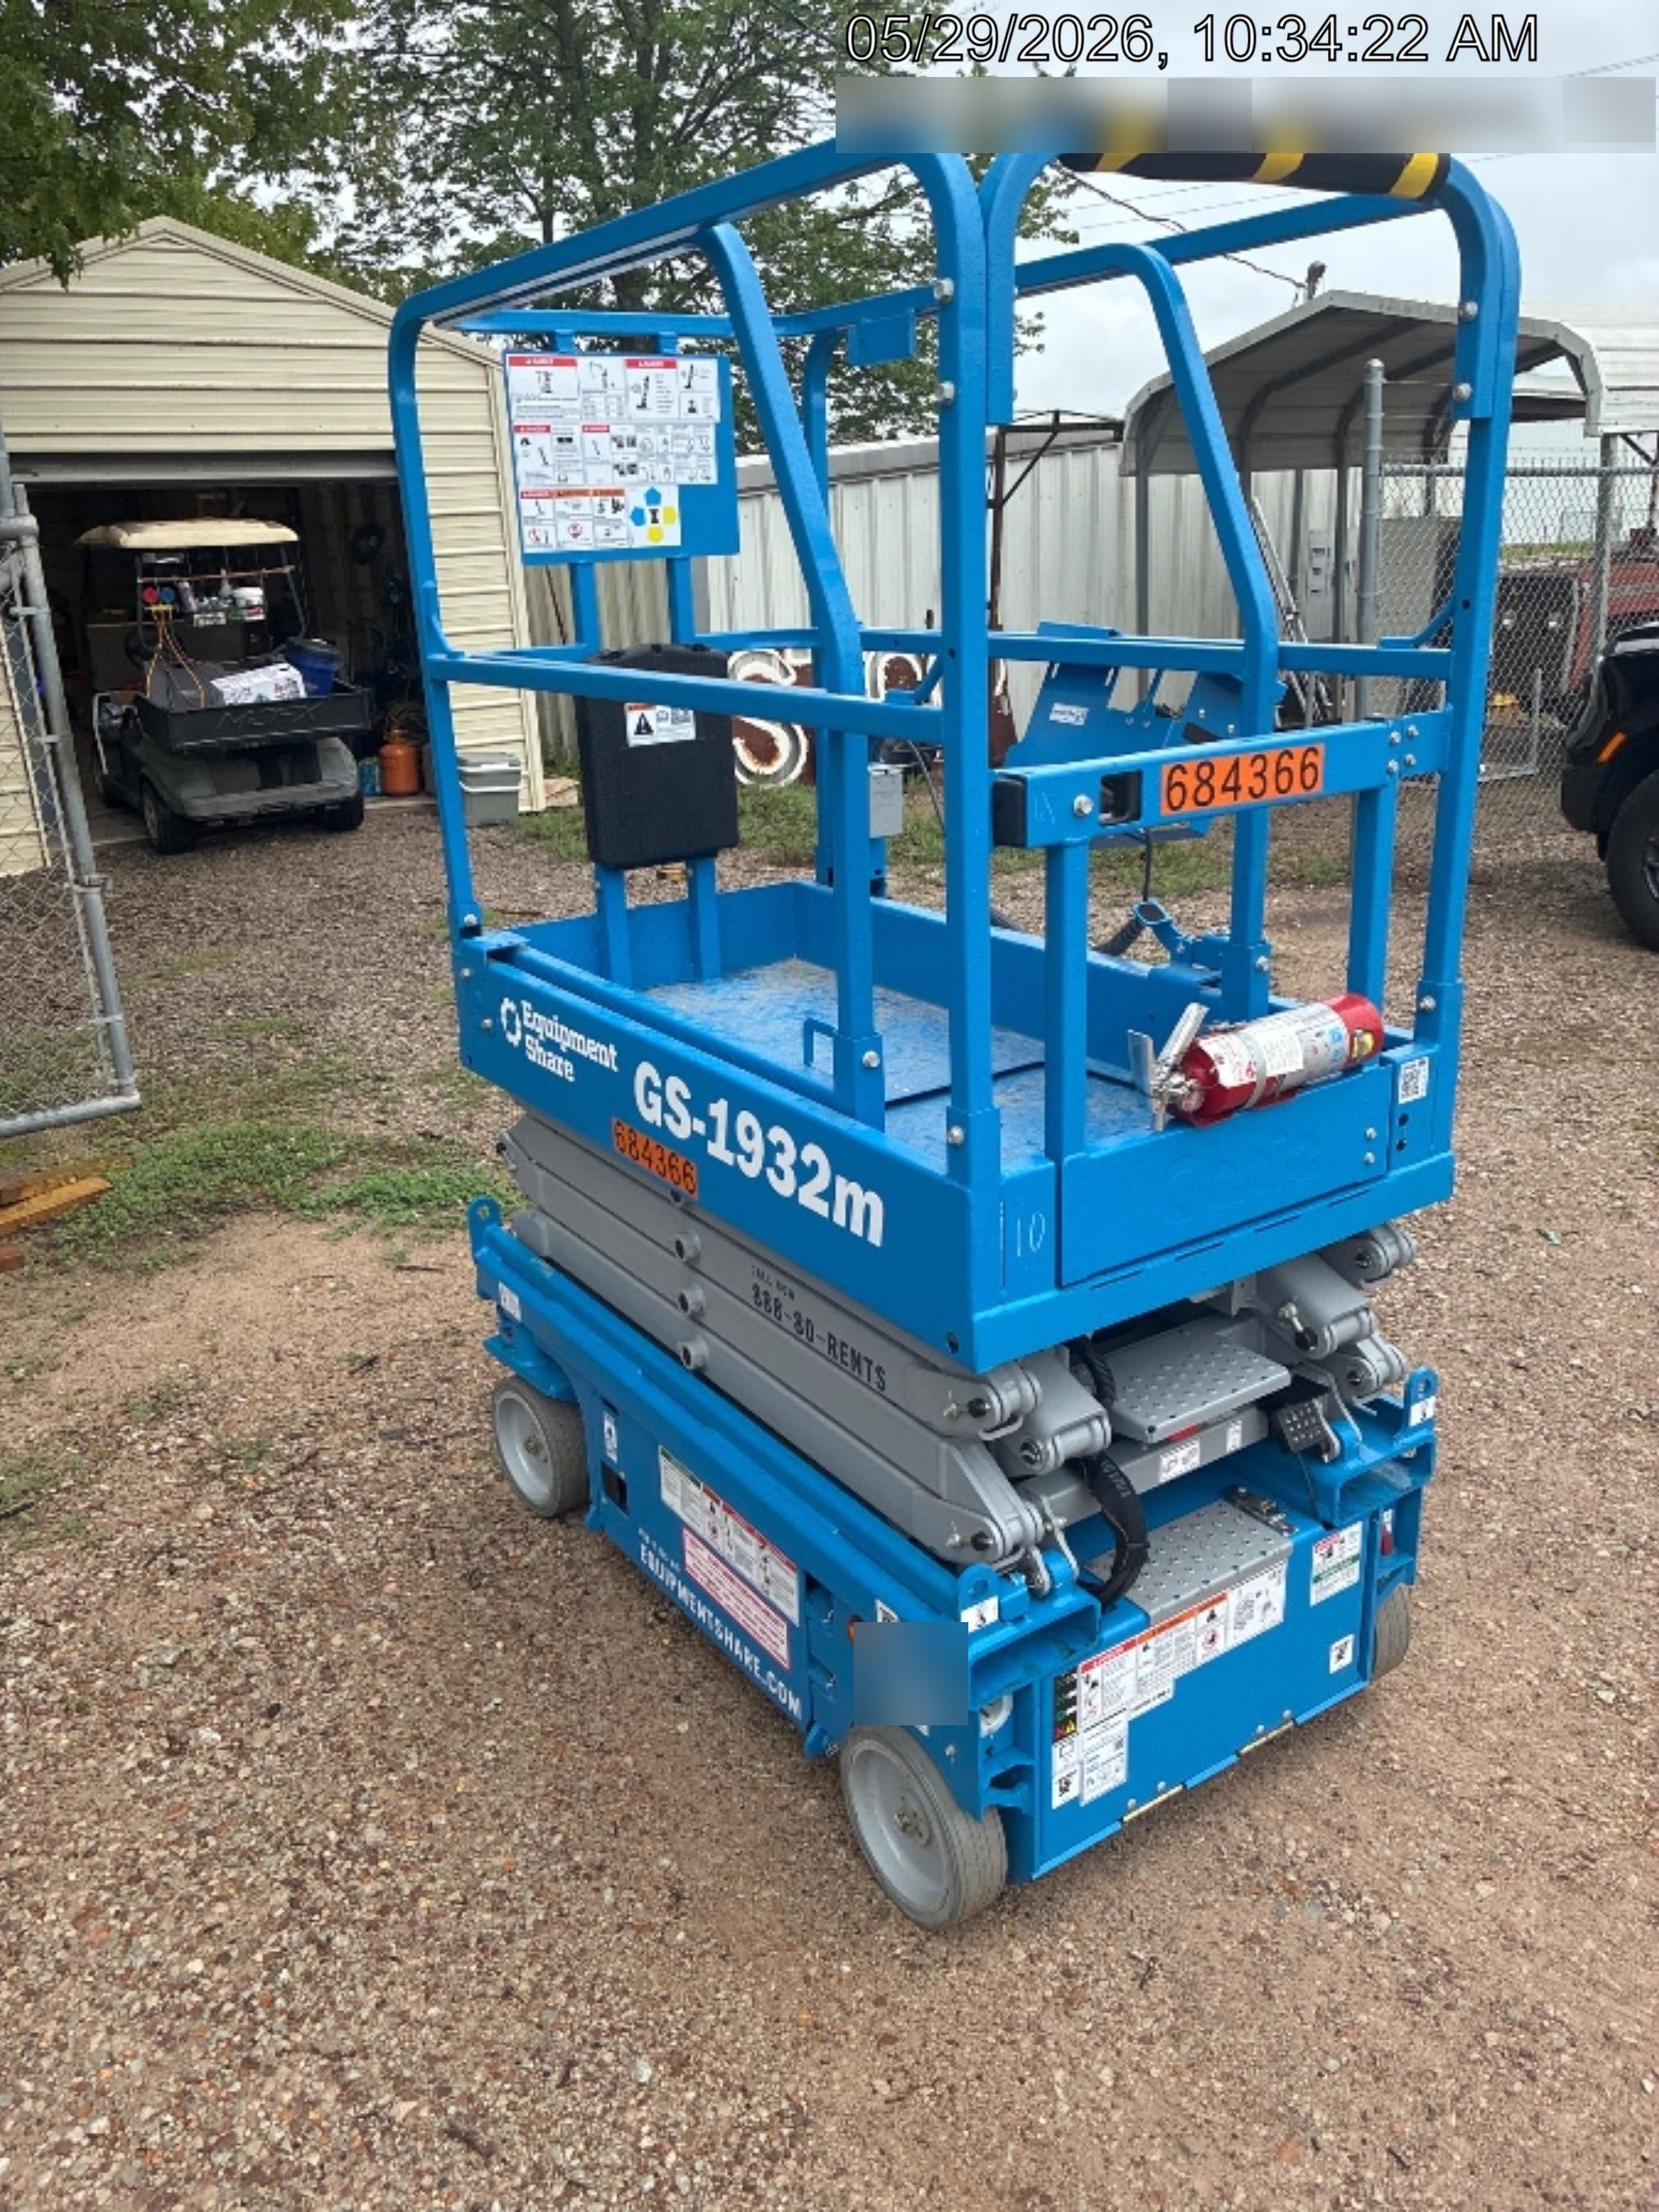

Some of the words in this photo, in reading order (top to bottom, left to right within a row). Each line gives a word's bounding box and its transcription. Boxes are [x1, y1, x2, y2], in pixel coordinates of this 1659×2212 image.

[1166, 746, 1320, 812] 684366
[521, 999, 619, 1072] Equipment
[525, 1034, 575, 1082] Share
[614, 1121, 696, 1197] 684366
[633, 1061, 884, 1248] GS-1932m
